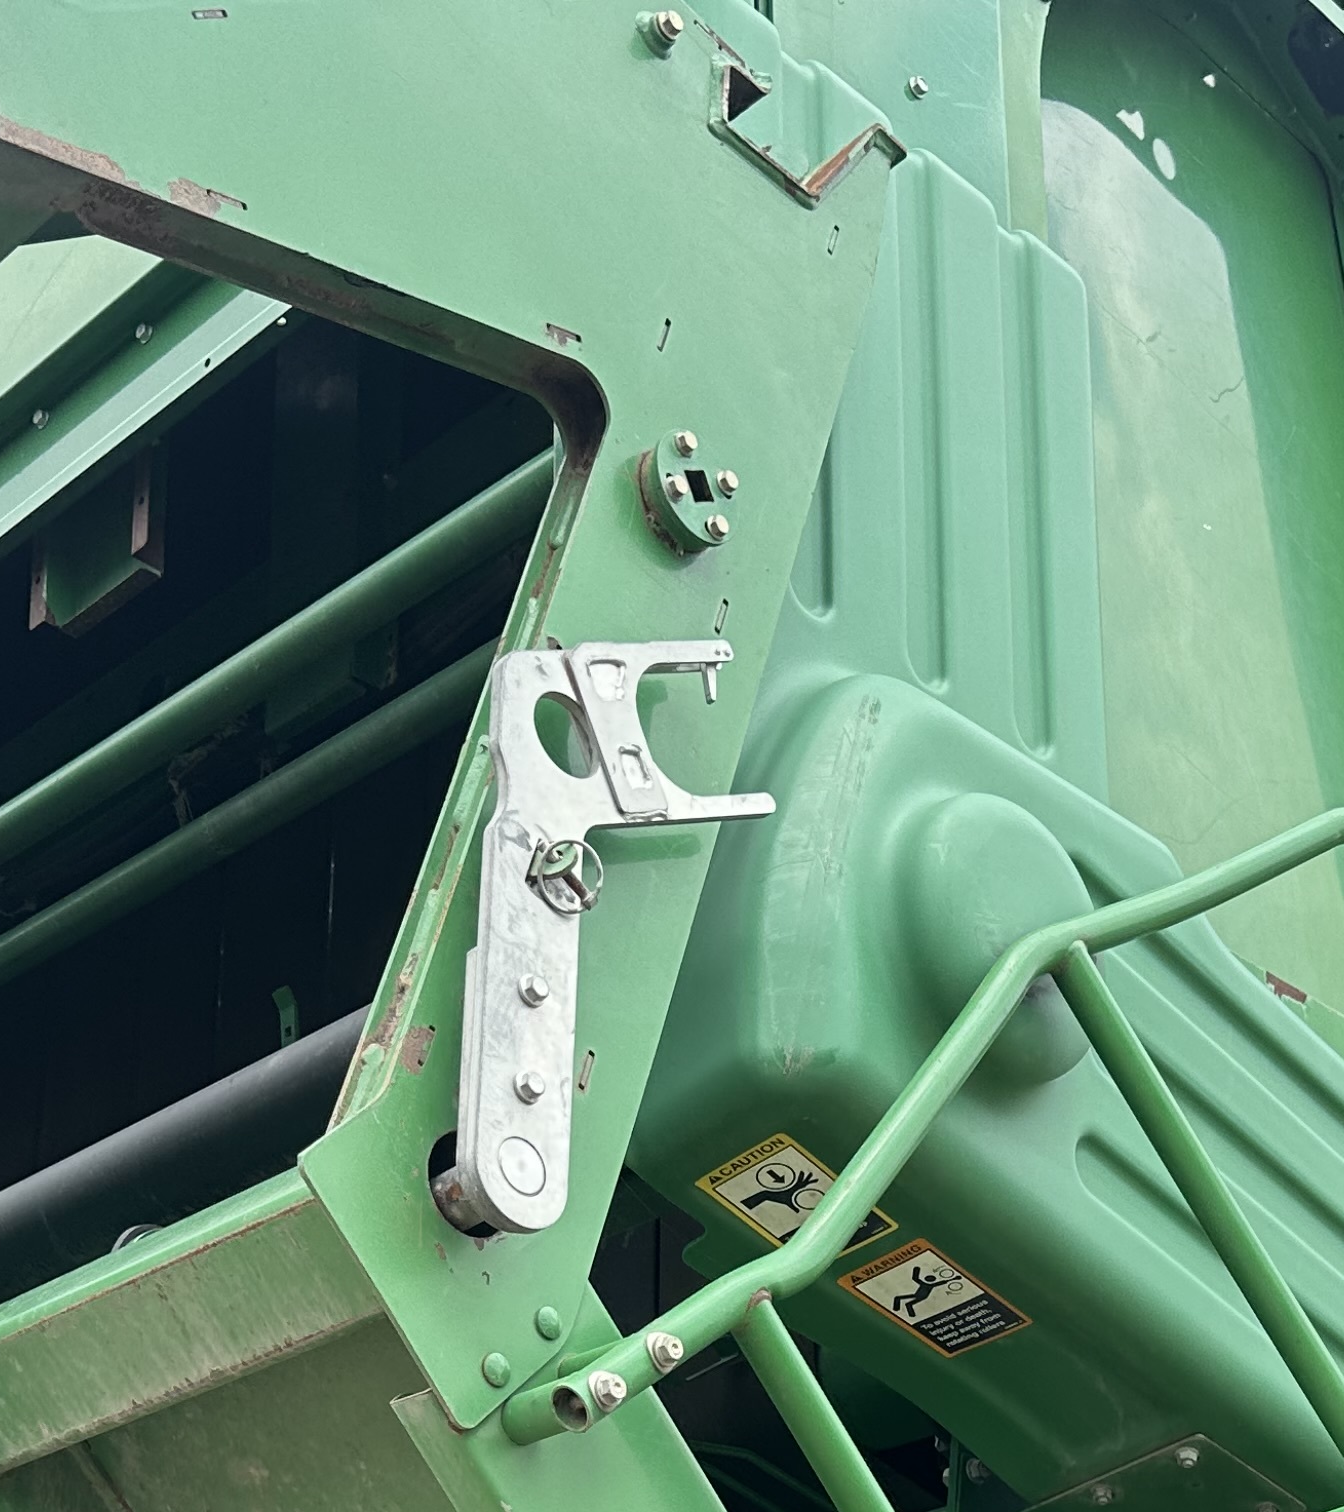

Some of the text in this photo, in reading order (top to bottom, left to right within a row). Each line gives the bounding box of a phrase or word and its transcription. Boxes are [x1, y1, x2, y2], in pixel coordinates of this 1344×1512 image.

[717, 1136, 786, 1178] CAUTION
[860, 1243, 923, 1277] WARNING
[919, 1298, 989, 1331] To avoid serious
[927, 1322, 956, 1337] injury
[952, 1318, 966, 1326] or
[957, 1321, 981, 1334] away
[977, 1311, 1002, 1324] from
